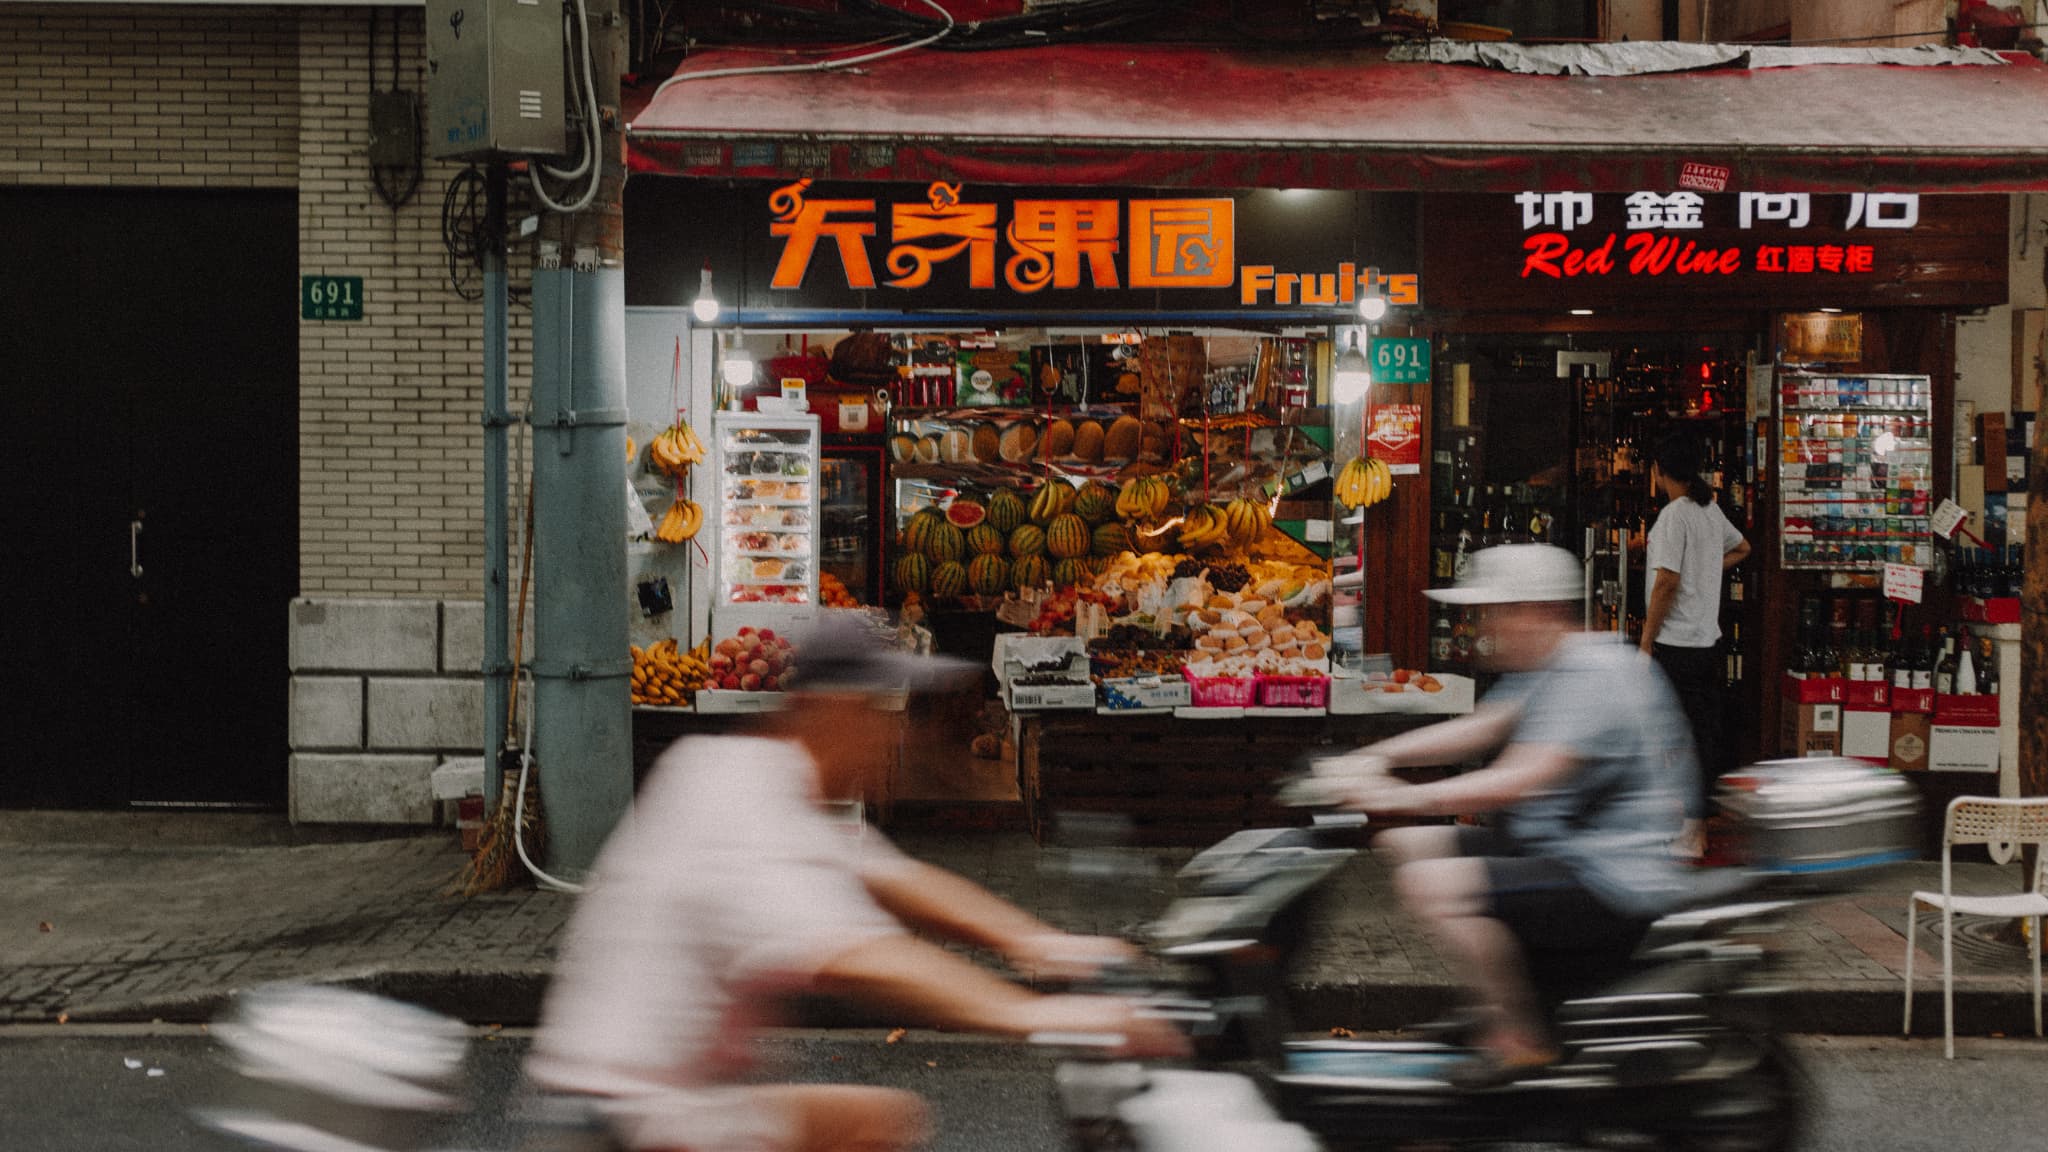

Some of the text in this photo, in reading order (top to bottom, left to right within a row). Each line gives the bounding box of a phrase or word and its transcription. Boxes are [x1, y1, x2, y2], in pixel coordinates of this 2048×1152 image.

[1520, 232, 1742, 279] Red Wine
[1755, 244, 1875, 273] 红酒专柜
[311, 281, 354, 305] 691
[1378, 343, 1421, 368] 691
